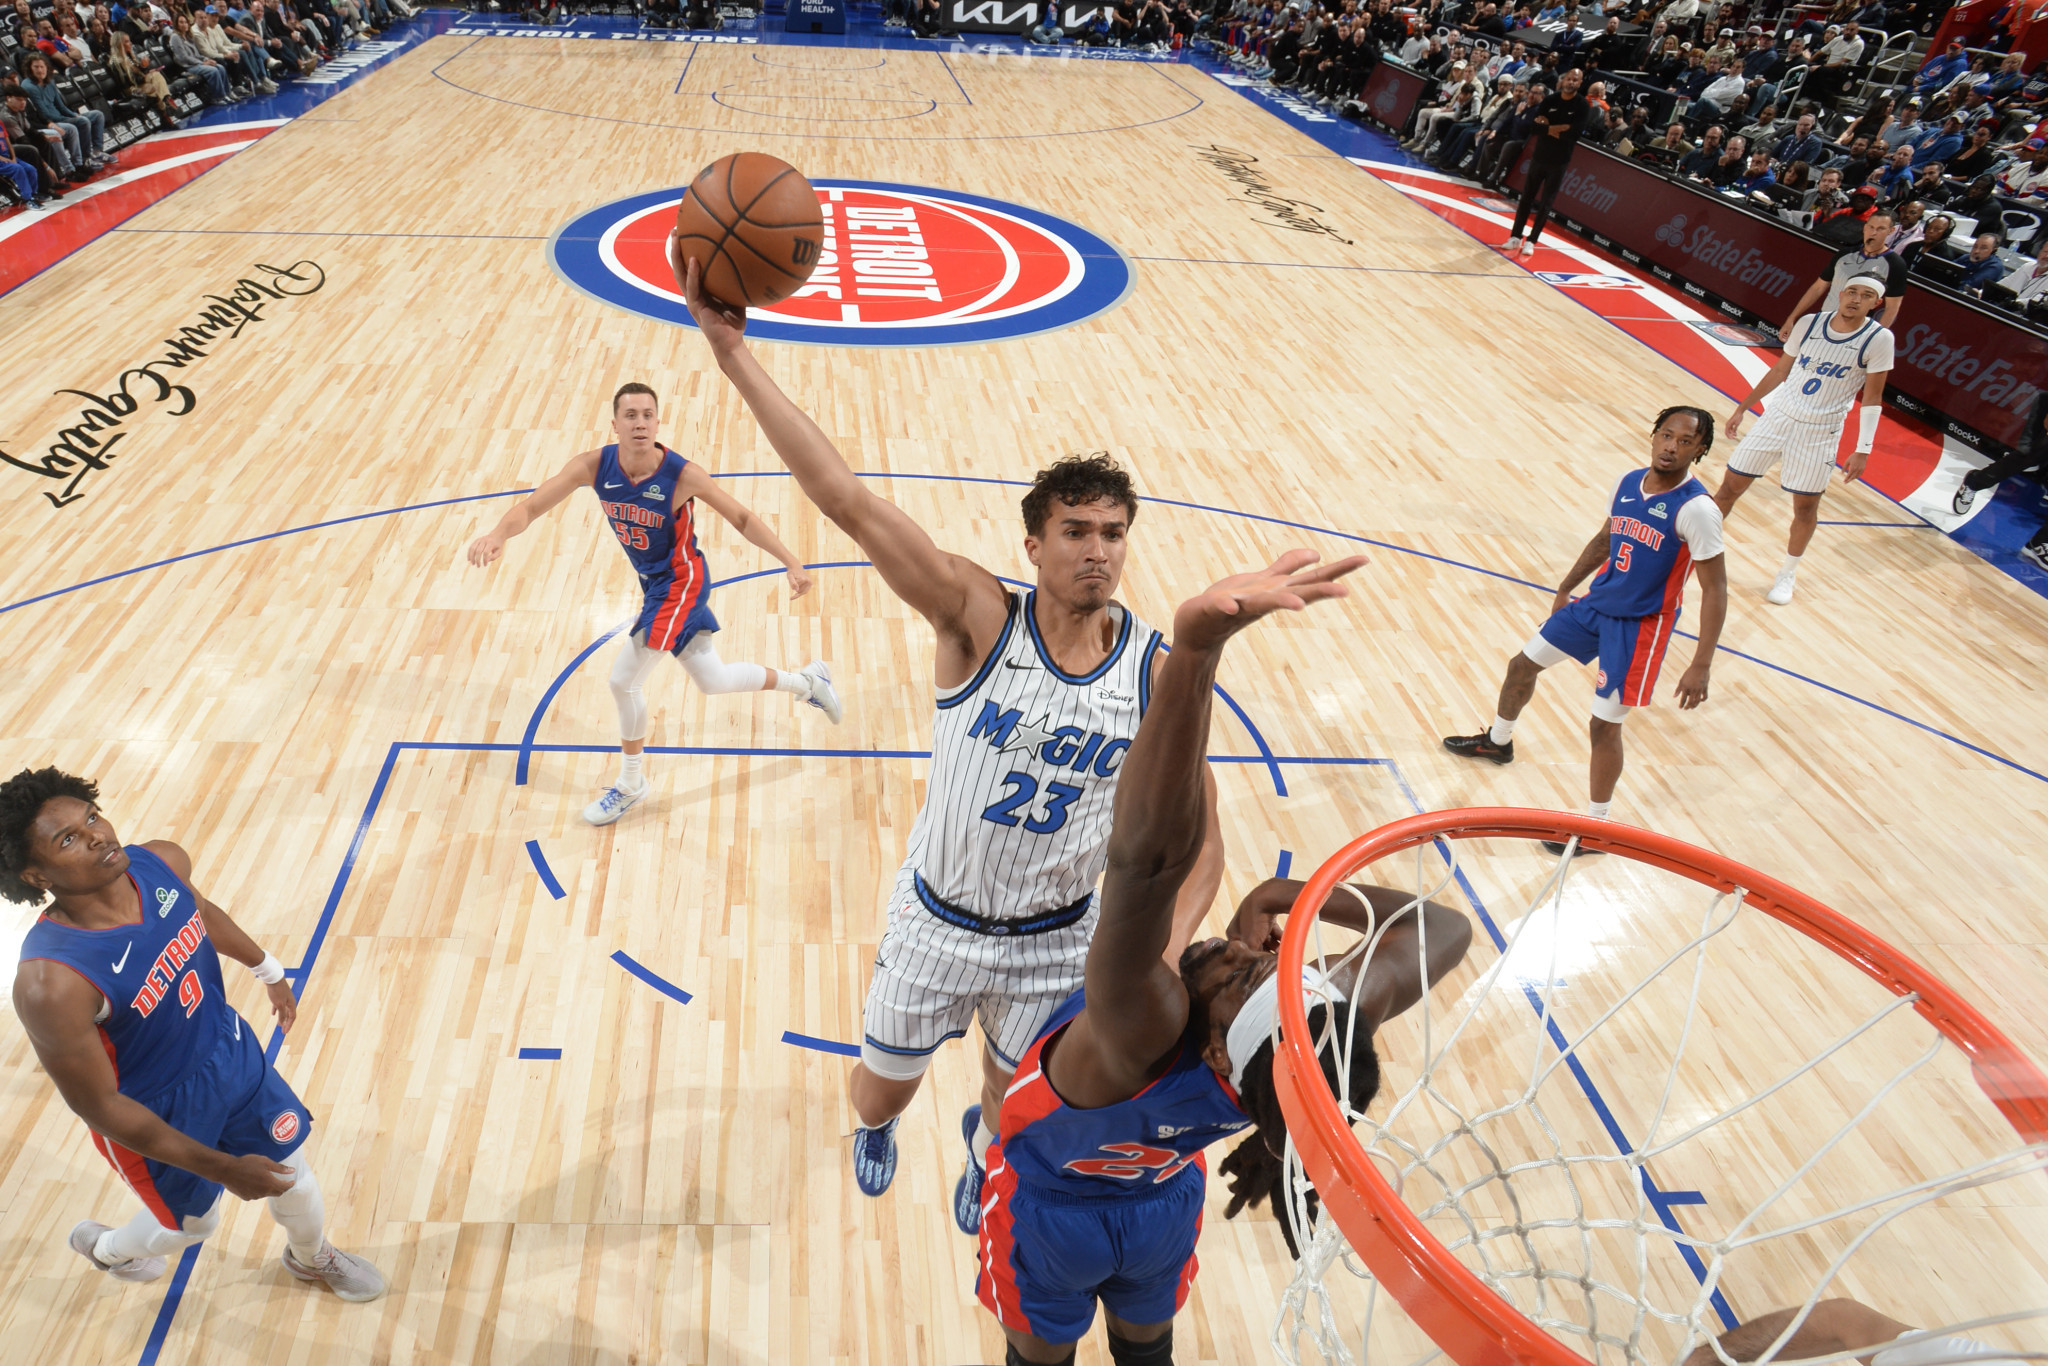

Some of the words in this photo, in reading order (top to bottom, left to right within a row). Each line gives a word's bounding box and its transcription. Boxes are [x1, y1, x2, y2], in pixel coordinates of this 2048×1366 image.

[445, 28, 597, 39] DETROIT
[611, 32, 759, 44] PISTONS
[845, 206, 943, 302] DETROIT
[1684, 282, 1706, 298] StockX
[141, 260, 326, 378] Platinum
[1721, 301, 1743, 318] StockX
[1801, 377, 1822, 396] 0
[1948, 422, 1981, 446] StockX
[600, 499, 666, 529] DETROIT
[614, 521, 650, 551] 55
[1610, 515, 1665, 552] DETROIT
[1615, 541, 1634, 573] 5
[980, 771, 1085, 835] 23
[130, 909, 208, 1019] DETROIT
[178, 969, 205, 1020] 9
